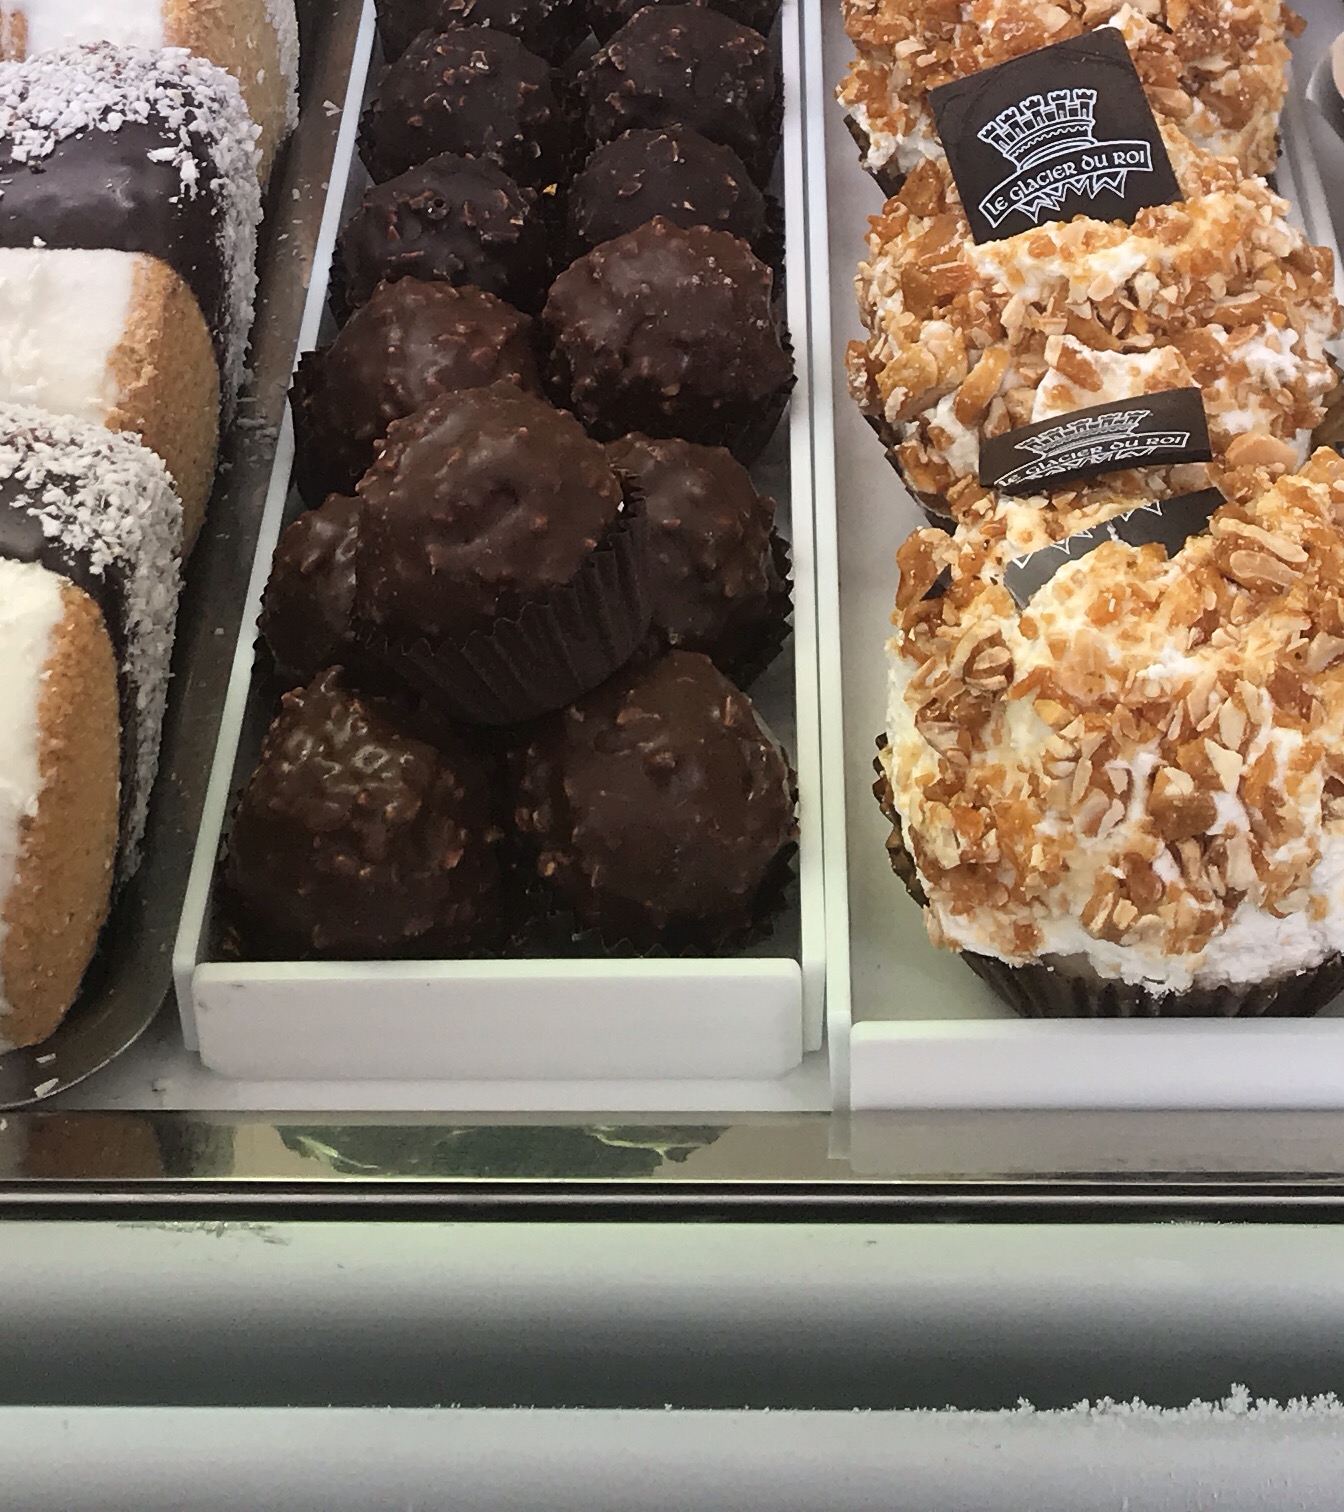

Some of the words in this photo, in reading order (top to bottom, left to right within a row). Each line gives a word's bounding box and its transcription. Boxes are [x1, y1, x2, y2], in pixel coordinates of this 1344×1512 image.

[985, 196, 1009, 216] LE
[1009, 161, 1078, 202] GLACIER
[1080, 153, 1109, 171] DU
[1112, 150, 1146, 166] ROI
